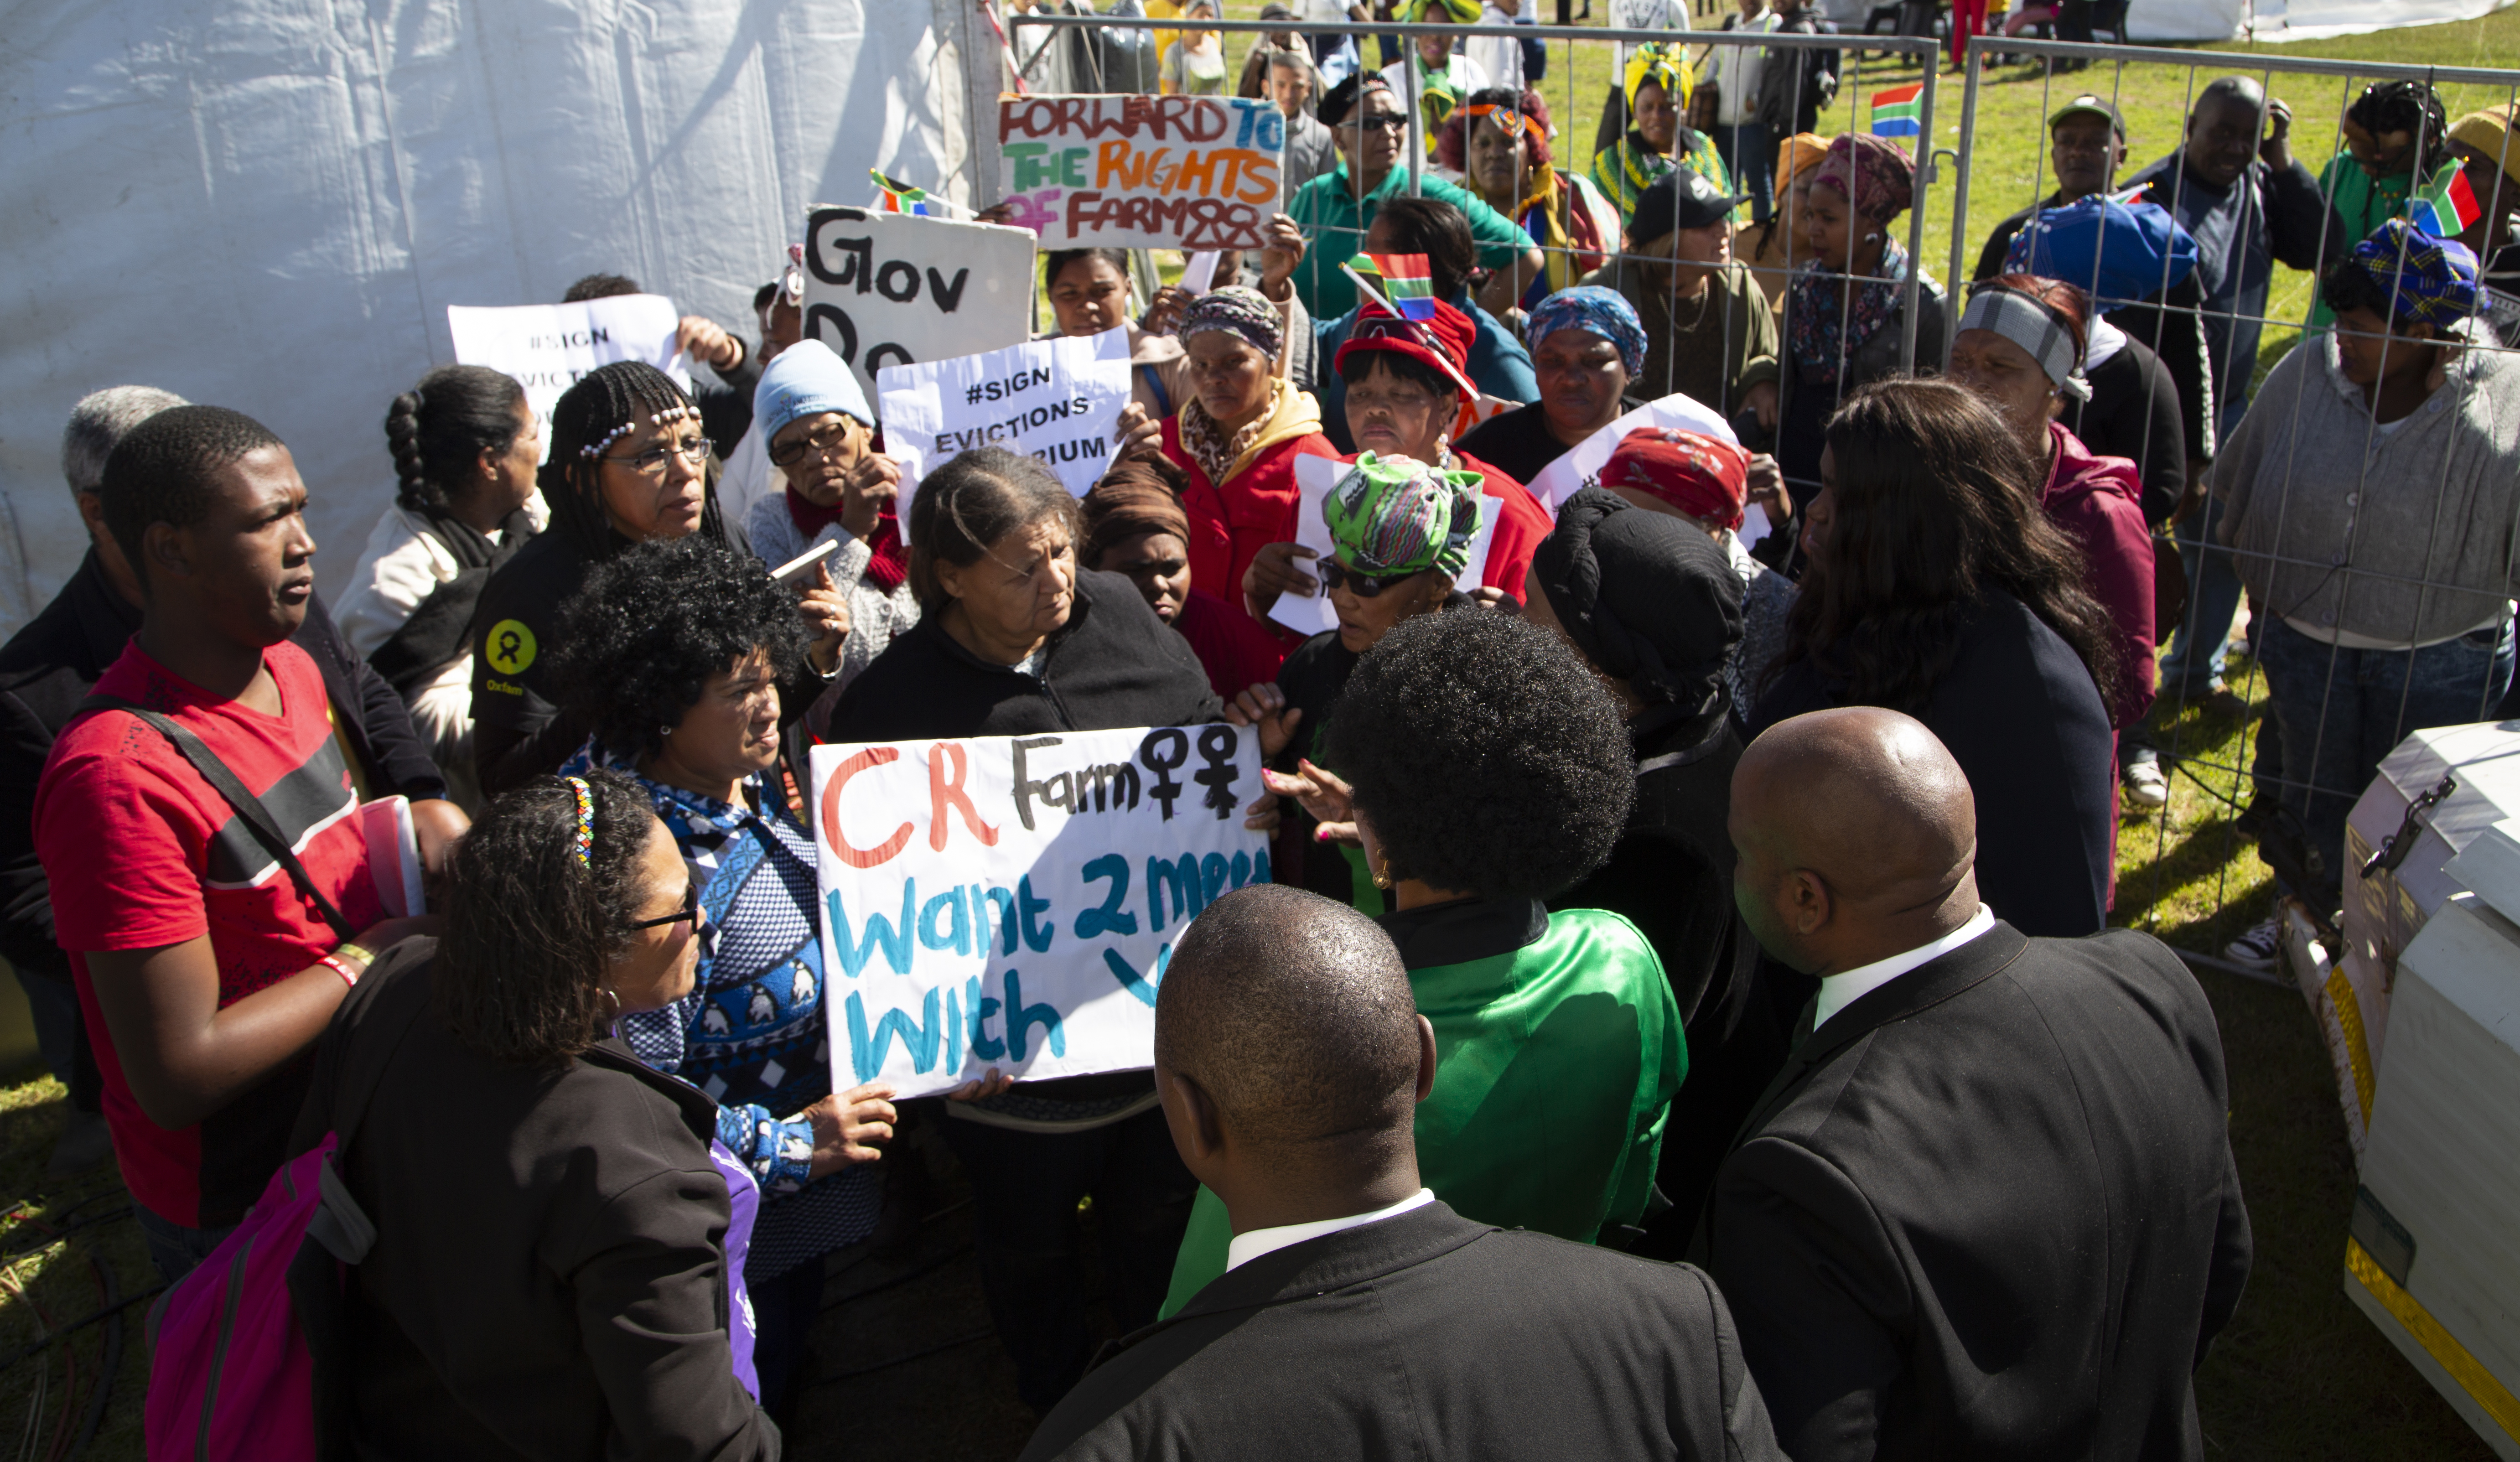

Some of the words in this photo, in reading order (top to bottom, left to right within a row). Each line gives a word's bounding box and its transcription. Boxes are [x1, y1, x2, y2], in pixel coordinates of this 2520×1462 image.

[999, 96, 1228, 142] FORWARD
[1231, 98, 1286, 152] TO
[1003, 142, 1090, 192] THE
[1096, 139, 1277, 205] RIGHTS
[1003, 188, 1061, 238] OF
[806, 209, 970, 313] Gov
[966, 367, 1051, 405] #SIGN
[935, 396, 1089, 453] EVICTIONS
[487, 679, 523, 696] Oxfam
[1074, 853, 1138, 939] 2
